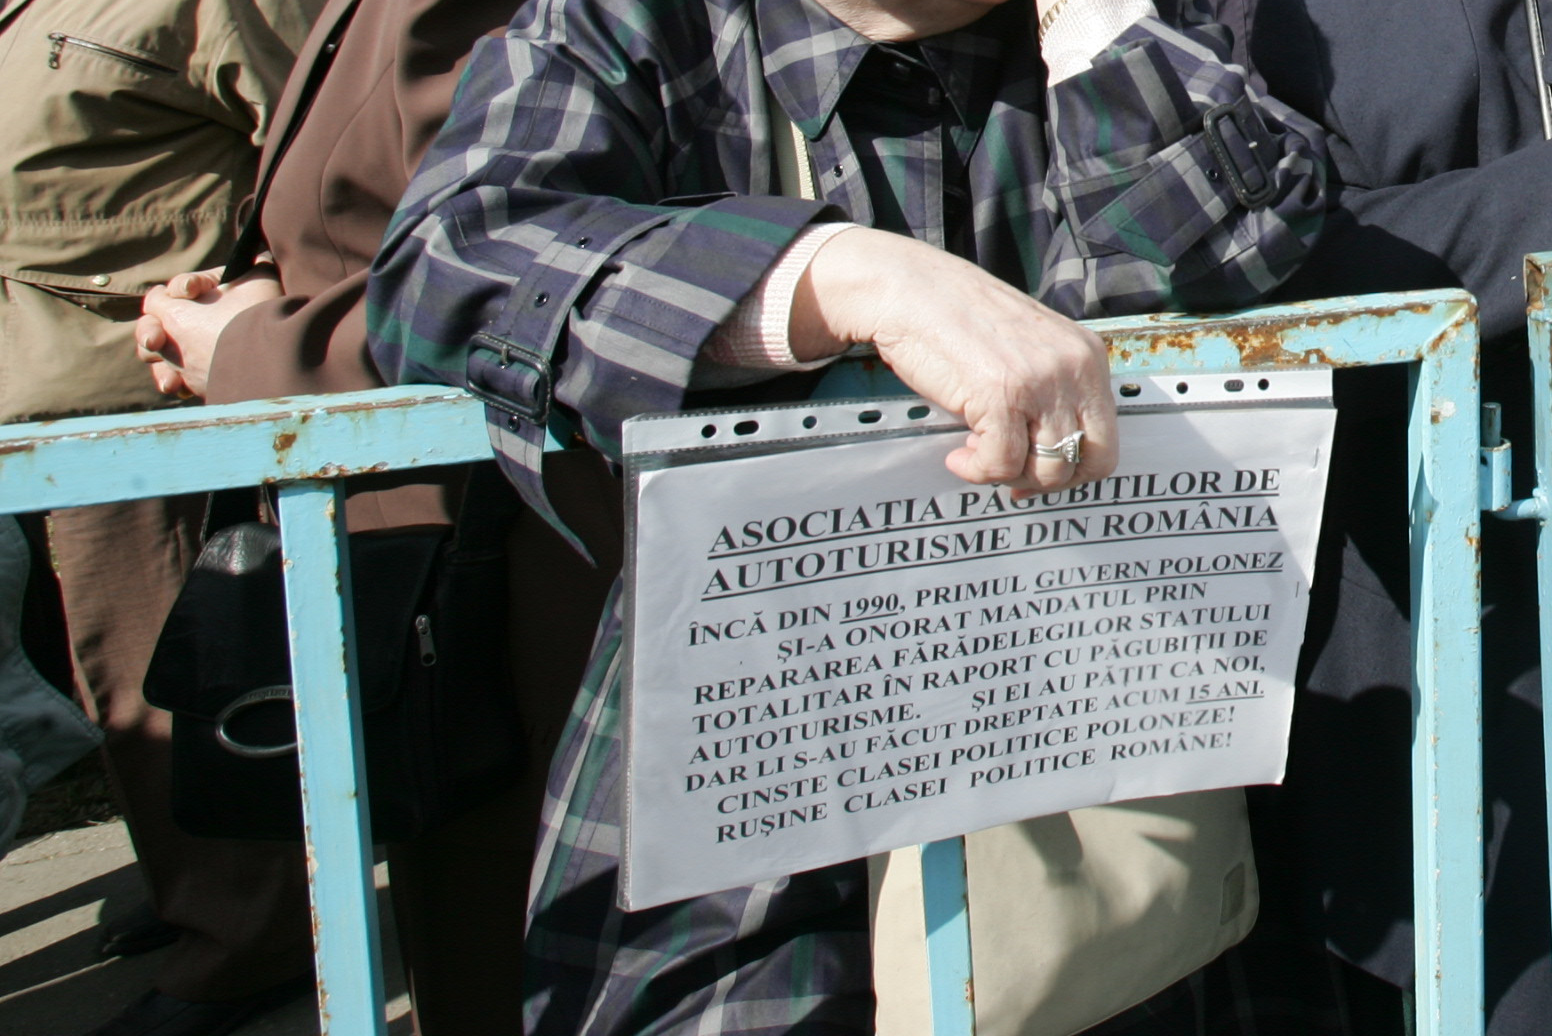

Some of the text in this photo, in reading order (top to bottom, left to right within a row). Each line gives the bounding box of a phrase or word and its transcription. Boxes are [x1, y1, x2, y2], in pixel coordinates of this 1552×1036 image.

[1232, 468, 1281, 493] DE
[702, 500, 1278, 595] AUTOTURISME DIN ROMÂNIA
[688, 551, 1284, 647] ÎNCĂ DIN 1990, PRIMUL GUVERN POLONEZ
[846, 611, 972, 647] ONORAT
[979, 589, 1136, 626] MANDATUL
[1145, 581, 1208, 604] PRIN
[692, 683, 874, 735] TOTALITAR
[882, 674, 914, 698] ÎN
[921, 654, 1038, 691] RAPORT
[1044, 647, 1082, 668] CU
[1234, 629, 1269, 648] DE
[694, 604, 1272, 705] REPARAREA FĂRĂDELEGILOR STATULUI
[685, 680, 1265, 793] DAR LI S-AU FĂCUT DREPTATE ACUM 15 ANI.
[689, 703, 921, 765] AUTOTURISME.
[1005, 682, 1031, 704] EI
[1039, 675, 1076, 697] AU
[1170, 658, 1204, 678] CA
[1213, 655, 1265, 675] NOI,
[717, 705, 1236, 814] CINSTE CLASEI POLITICE POLONEZE!
[843, 778, 948, 814] CLASEI
[970, 749, 1096, 789] POLITICE
[1110, 732, 1233, 761] ROMÂNE!
